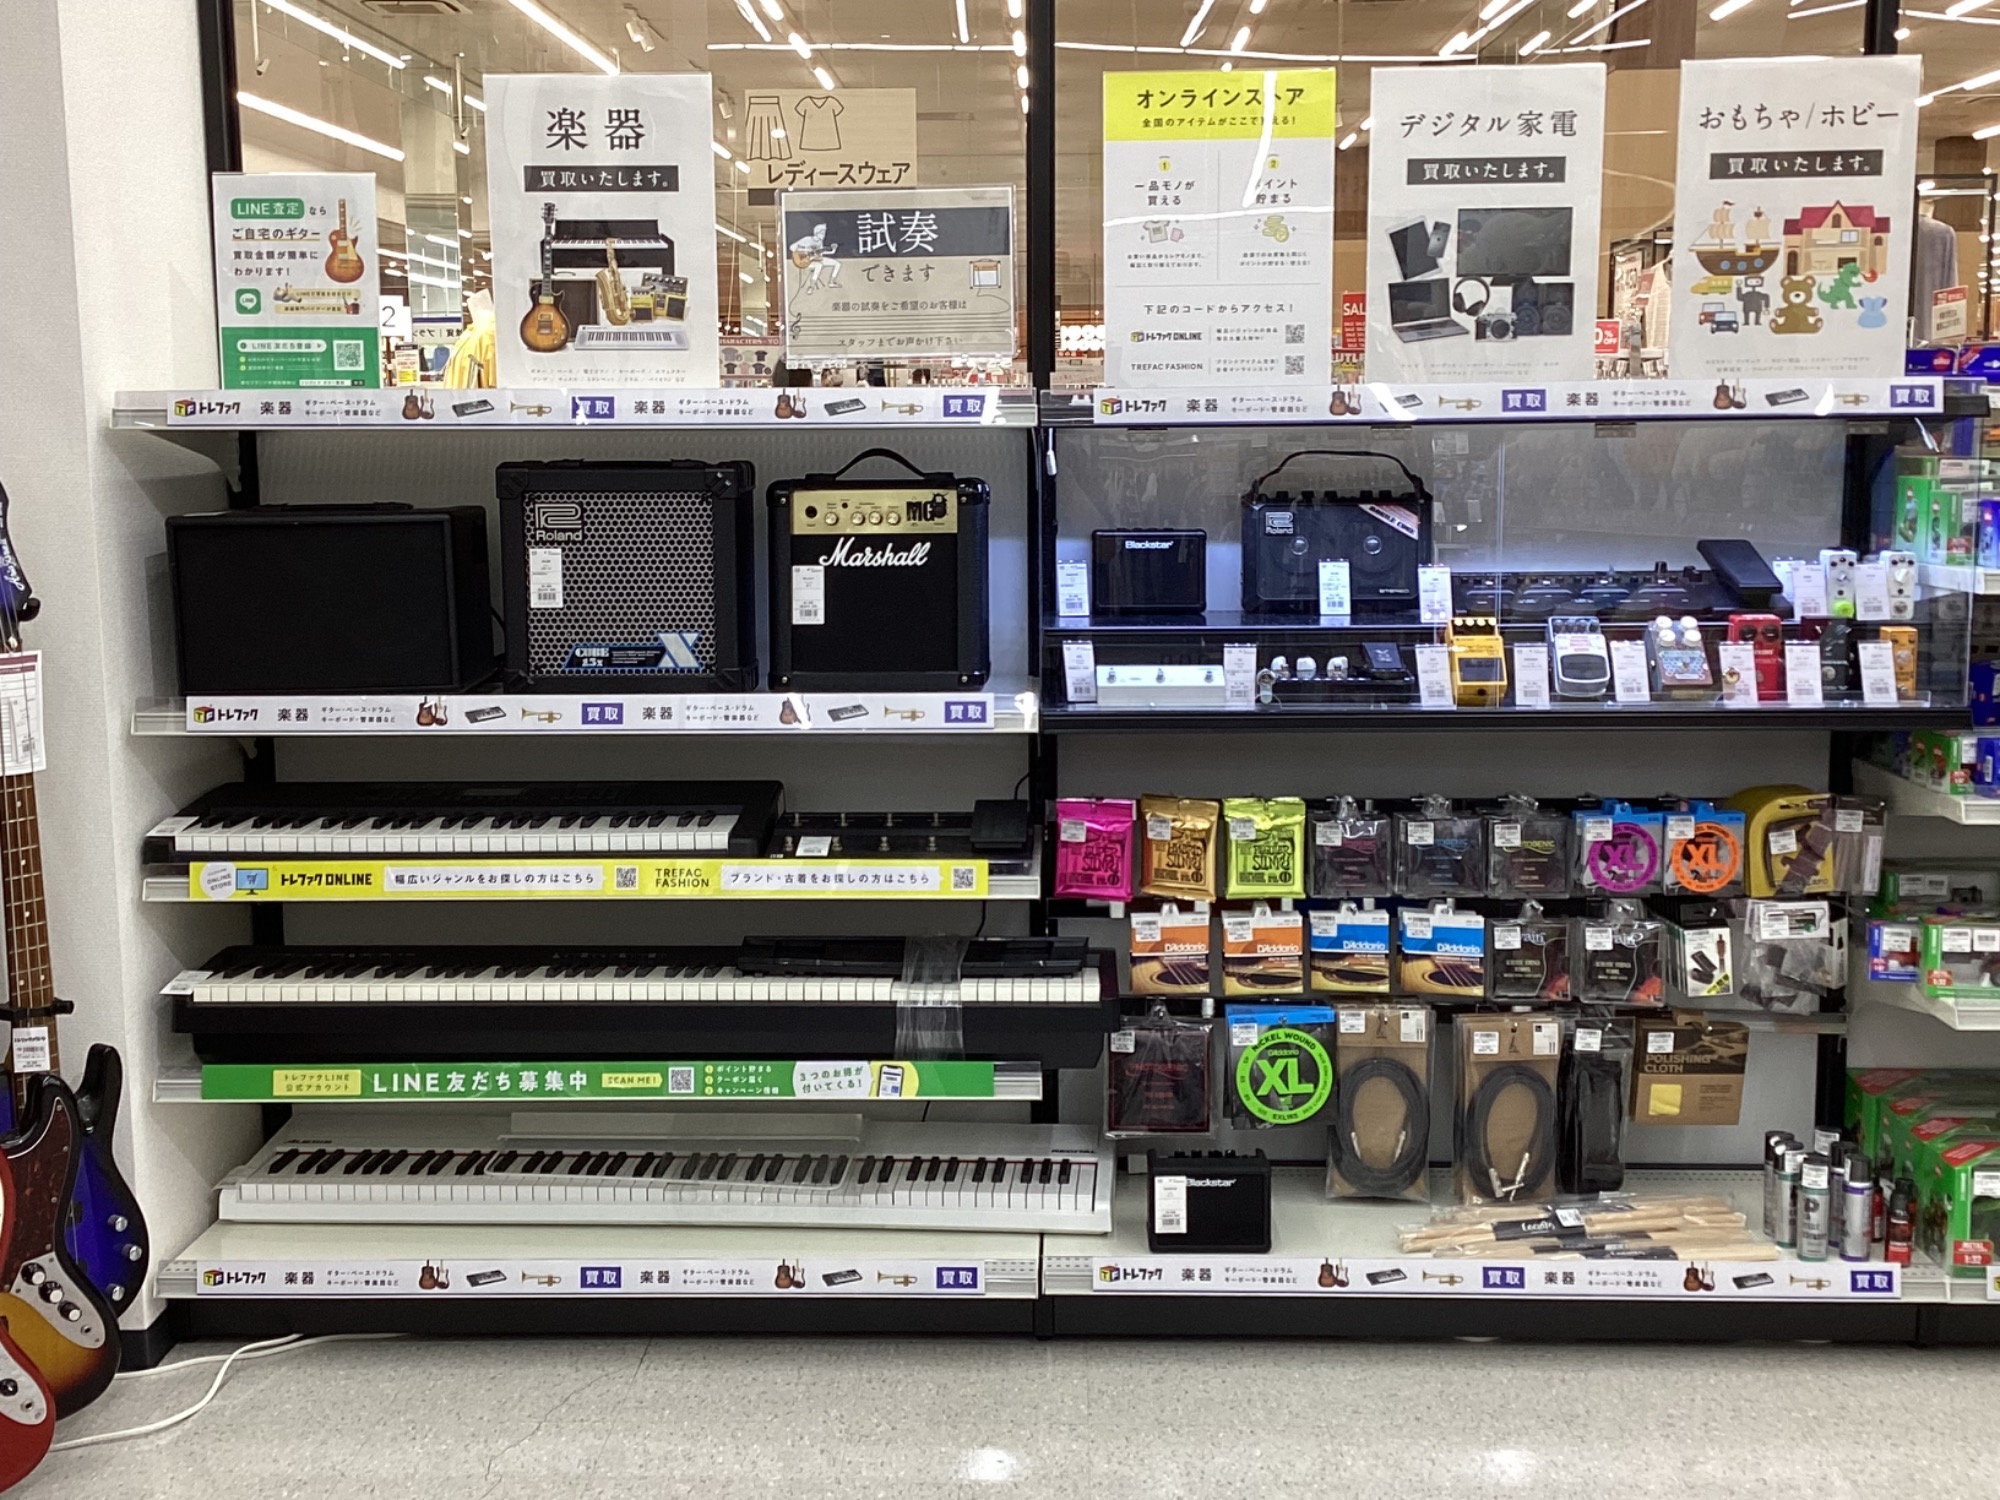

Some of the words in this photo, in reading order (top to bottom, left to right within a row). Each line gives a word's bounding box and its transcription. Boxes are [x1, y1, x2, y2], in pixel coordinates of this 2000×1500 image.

[1142, 116, 1297, 128] 全国のアイテムがここでえる！
[1700, 102, 1899, 130] おもちゃ/ホビー
[546, 107, 646, 150] 楽器
[1400, 109, 1577, 138] デジタル家電
[1423, 161, 1554, 180] 買取いたします。
[1728, 155, 1870, 174] 買取いたします。
[540, 169, 670, 189] 買取いたします。
[767, 160, 911, 186] レディースウェア
[1134, 180, 1195, 191] 一品モノが
[1256, 178, 1298, 190] イント
[1148, 195, 1182, 206] 買える
[237, 202, 299, 216] LINE査定
[309, 206, 327, 216] なら
[232, 228, 320, 240] ご自宅のギター
[857, 211, 939, 255] 試奏
[233, 250, 319, 260] 買取金額が簡単に
[234, 267, 290, 276] わかります！
[862, 264, 936, 283] できます
[832, 300, 967, 312] 楽器の試奏をご希望のお客様は
[1144, 303, 1294, 316] 下記のコードからアクセス！
[1343, 303, 1366, 316] SAL
[839, 336, 963, 347] スタッフまでお声かけ下さい
[1131, 363, 1164, 371] TREFAC
[1508, 394, 1541, 409] 買取
[1566, 392, 1599, 407] 楽器
[1896, 389, 1930, 403] 買取
[260, 401, 292, 416] 楽器
[577, 400, 610, 415] 買取
[634, 401, 666, 415] 楽器
[949, 399, 982, 414] 買取
[1186, 399, 1219, 413] 楽器
[535, 530, 583, 541] Roland
[819, 536, 932, 567] Marshall
[1125, 540, 1174, 549] Blackstar
[278, 708, 309, 722] 楽器
[587, 707, 618, 721] 買取
[642, 706, 673, 720] 楽器
[949, 705, 982, 719] 買取
[1604, 845, 1643, 870] XL
[1688, 844, 1726, 870] XL
[207, 873, 231, 883] ONLINE
[395, 873, 595, 886] 幅広いジャンルをお探しの方はこちら
[655, 868, 702, 878] TREFAC
[731, 873, 930, 886] ブランド・古着をお探しの方はこちら
[211, 881, 232, 892] STORE
[655, 878, 710, 889] FASHION
[1252, 1033, 1282, 1052] NICKEL
[1284, 1032, 1316, 1050] WOUND
[1646, 1054, 1711, 1064] POLISHING
[717, 1065, 772, 1073] ポイント貯まる
[1644, 1064, 1684, 1073] CLOTH
[607, 1076, 634, 1085] SCAN
[717, 1075, 763, 1084] クーポン届く
[1256, 1057, 1315, 1096] XL
[285, 1083, 349, 1092] 公式アカウント
[803, 1080, 863, 1094] 付いてくる！
[1186, 1178, 1236, 1187] Blackstar
[285, 1271, 315, 1285] 楽器
[585, 1270, 617, 1284] 買取
[640, 1270, 671, 1284] 楽器
[941, 1271, 973, 1285] 買取
[1181, 1268, 1212, 1282] 楽器
[1487, 1270, 1521, 1285] 買取
[1544, 1271, 1576, 1285] 楽器
[1855, 1274, 1889, 1288] 買取
